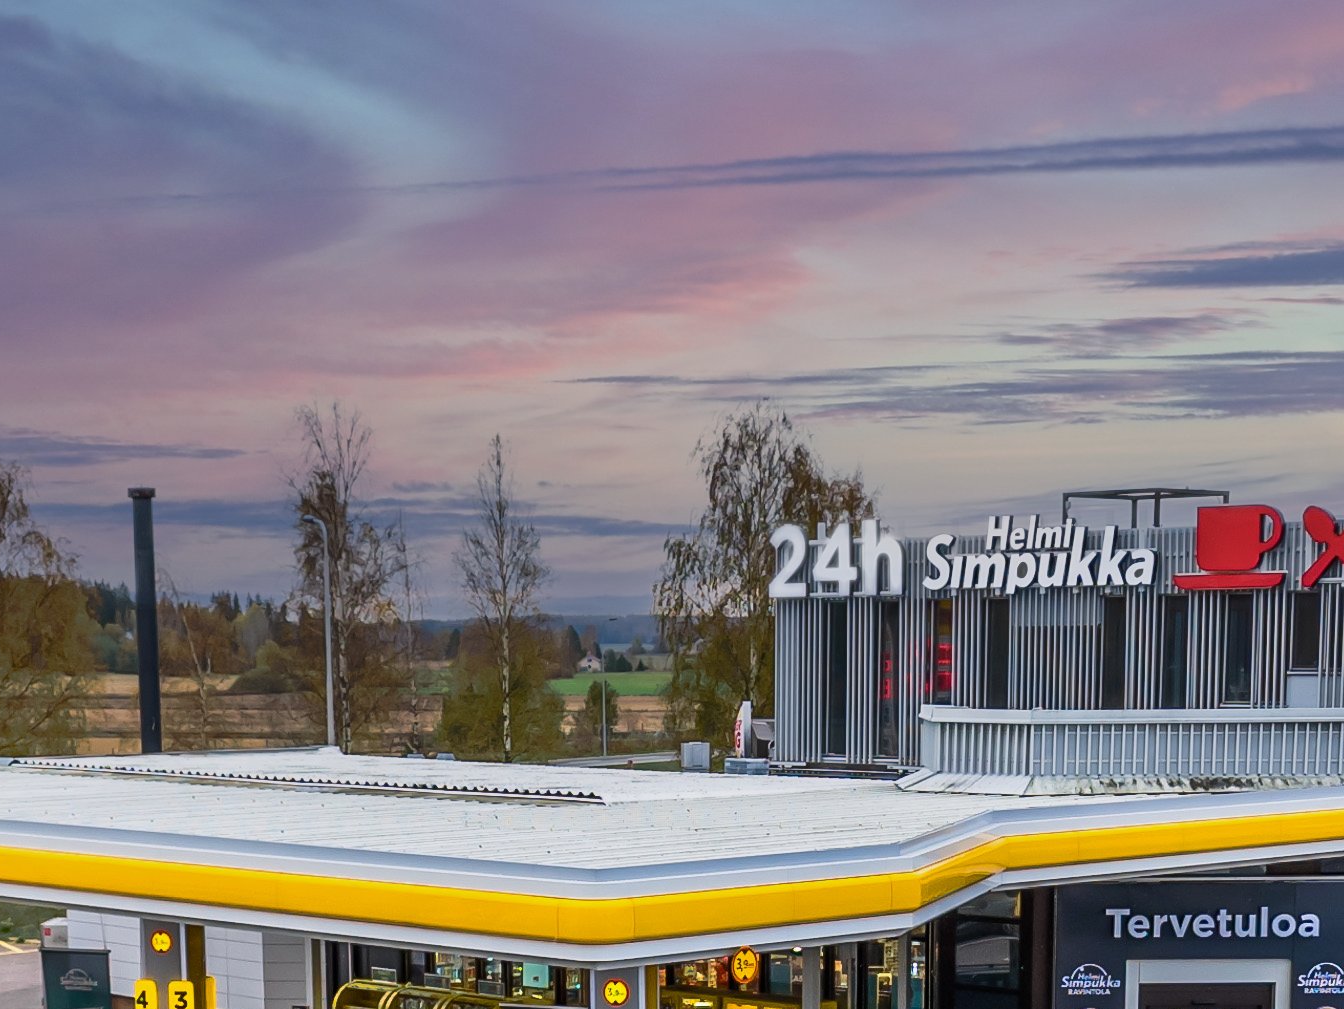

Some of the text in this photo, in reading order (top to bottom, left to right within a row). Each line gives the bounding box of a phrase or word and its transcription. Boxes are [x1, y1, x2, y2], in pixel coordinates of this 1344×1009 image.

[986, 515, 1074, 550] Helmi
[769, 519, 905, 598] 24h
[922, 525, 1158, 594] Simpukka
[1106, 906, 1321, 938] Tervetuloa
[1061, 974, 1121, 989] Simpukka
[136, 990, 188, 1009] 4 3
